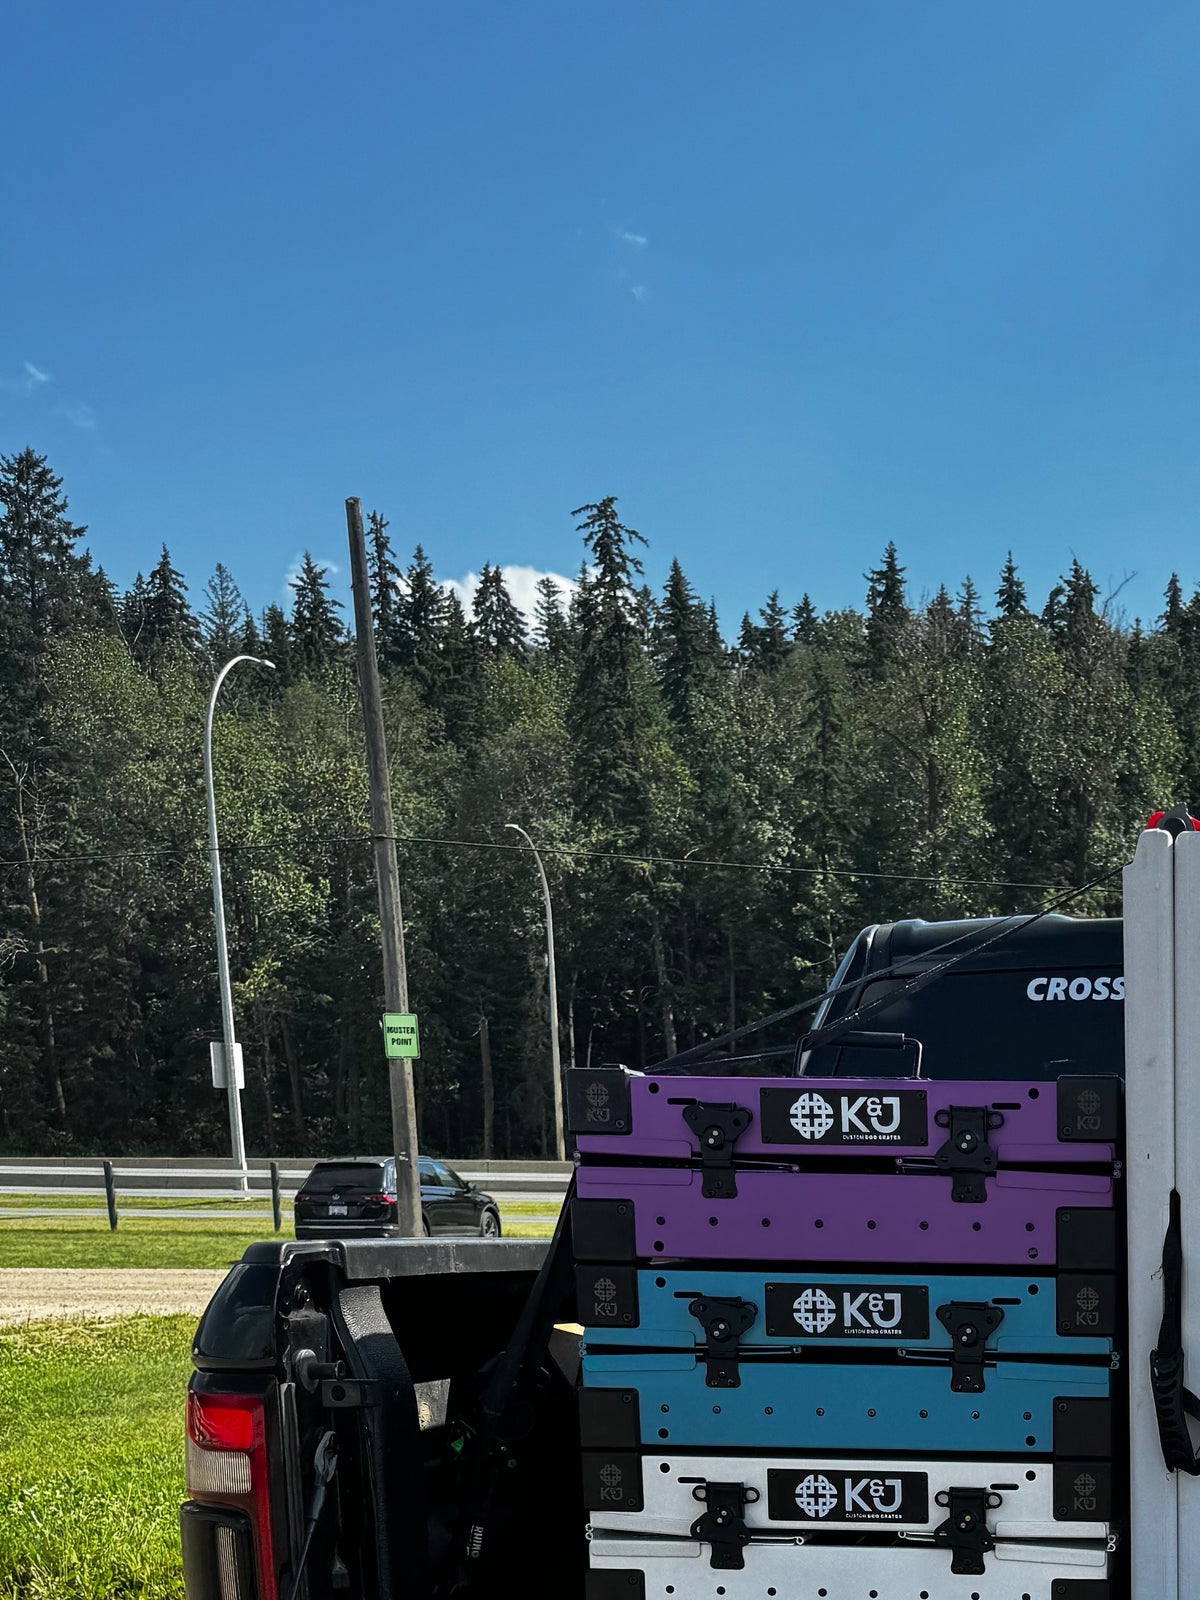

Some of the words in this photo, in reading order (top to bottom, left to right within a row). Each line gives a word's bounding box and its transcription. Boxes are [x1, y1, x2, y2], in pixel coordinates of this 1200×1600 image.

[1026, 976, 1126, 1002] CROSS
[386, 1026, 416, 1034] MUSTER
[391, 1038, 412, 1046] POINT
[841, 1095, 902, 1133] K&J
[843, 1291, 902, 1329] K&J
[844, 1477, 902, 1512] K&J
[471, 1525, 485, 1559] RHINO
